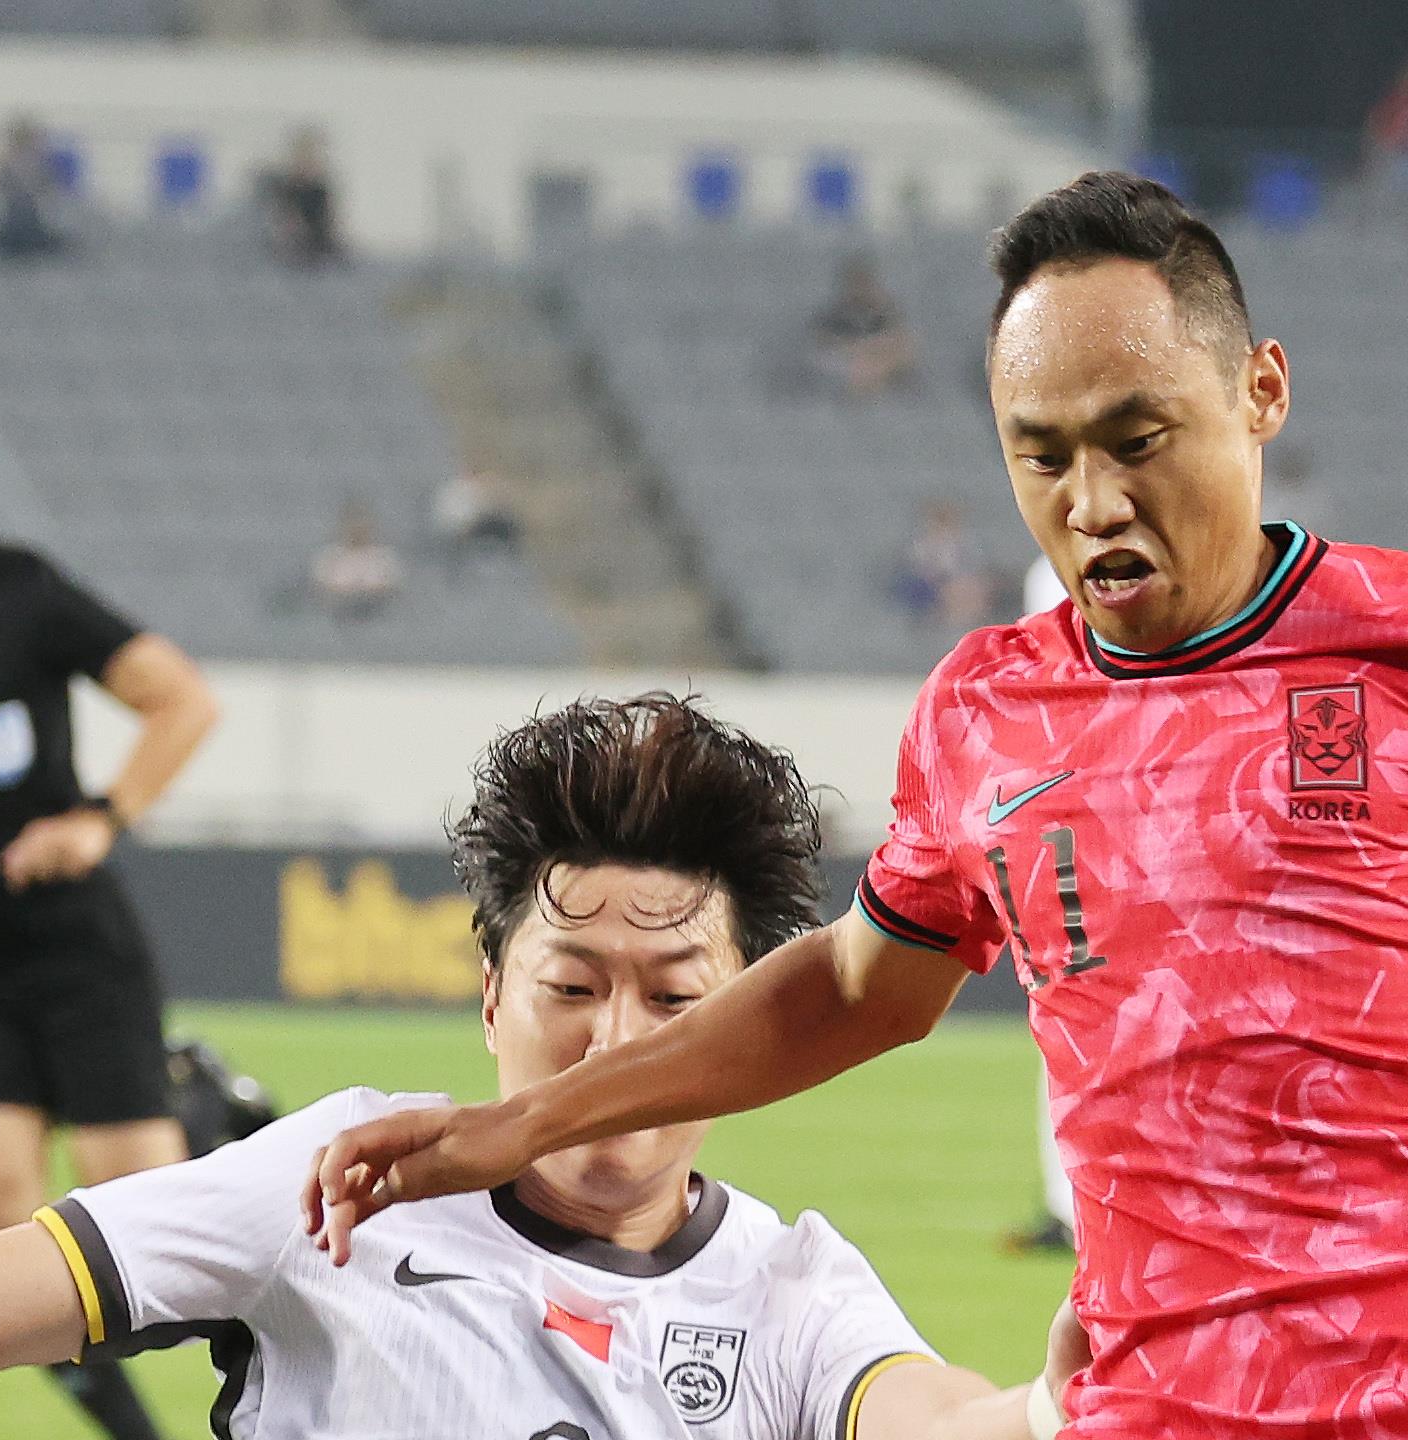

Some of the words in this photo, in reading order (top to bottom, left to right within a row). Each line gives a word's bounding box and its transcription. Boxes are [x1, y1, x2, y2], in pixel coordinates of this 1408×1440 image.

[1289, 801, 1371, 821] KOREA
[985, 826, 1108, 994] 11
[672, 1329, 737, 1350] CFA
